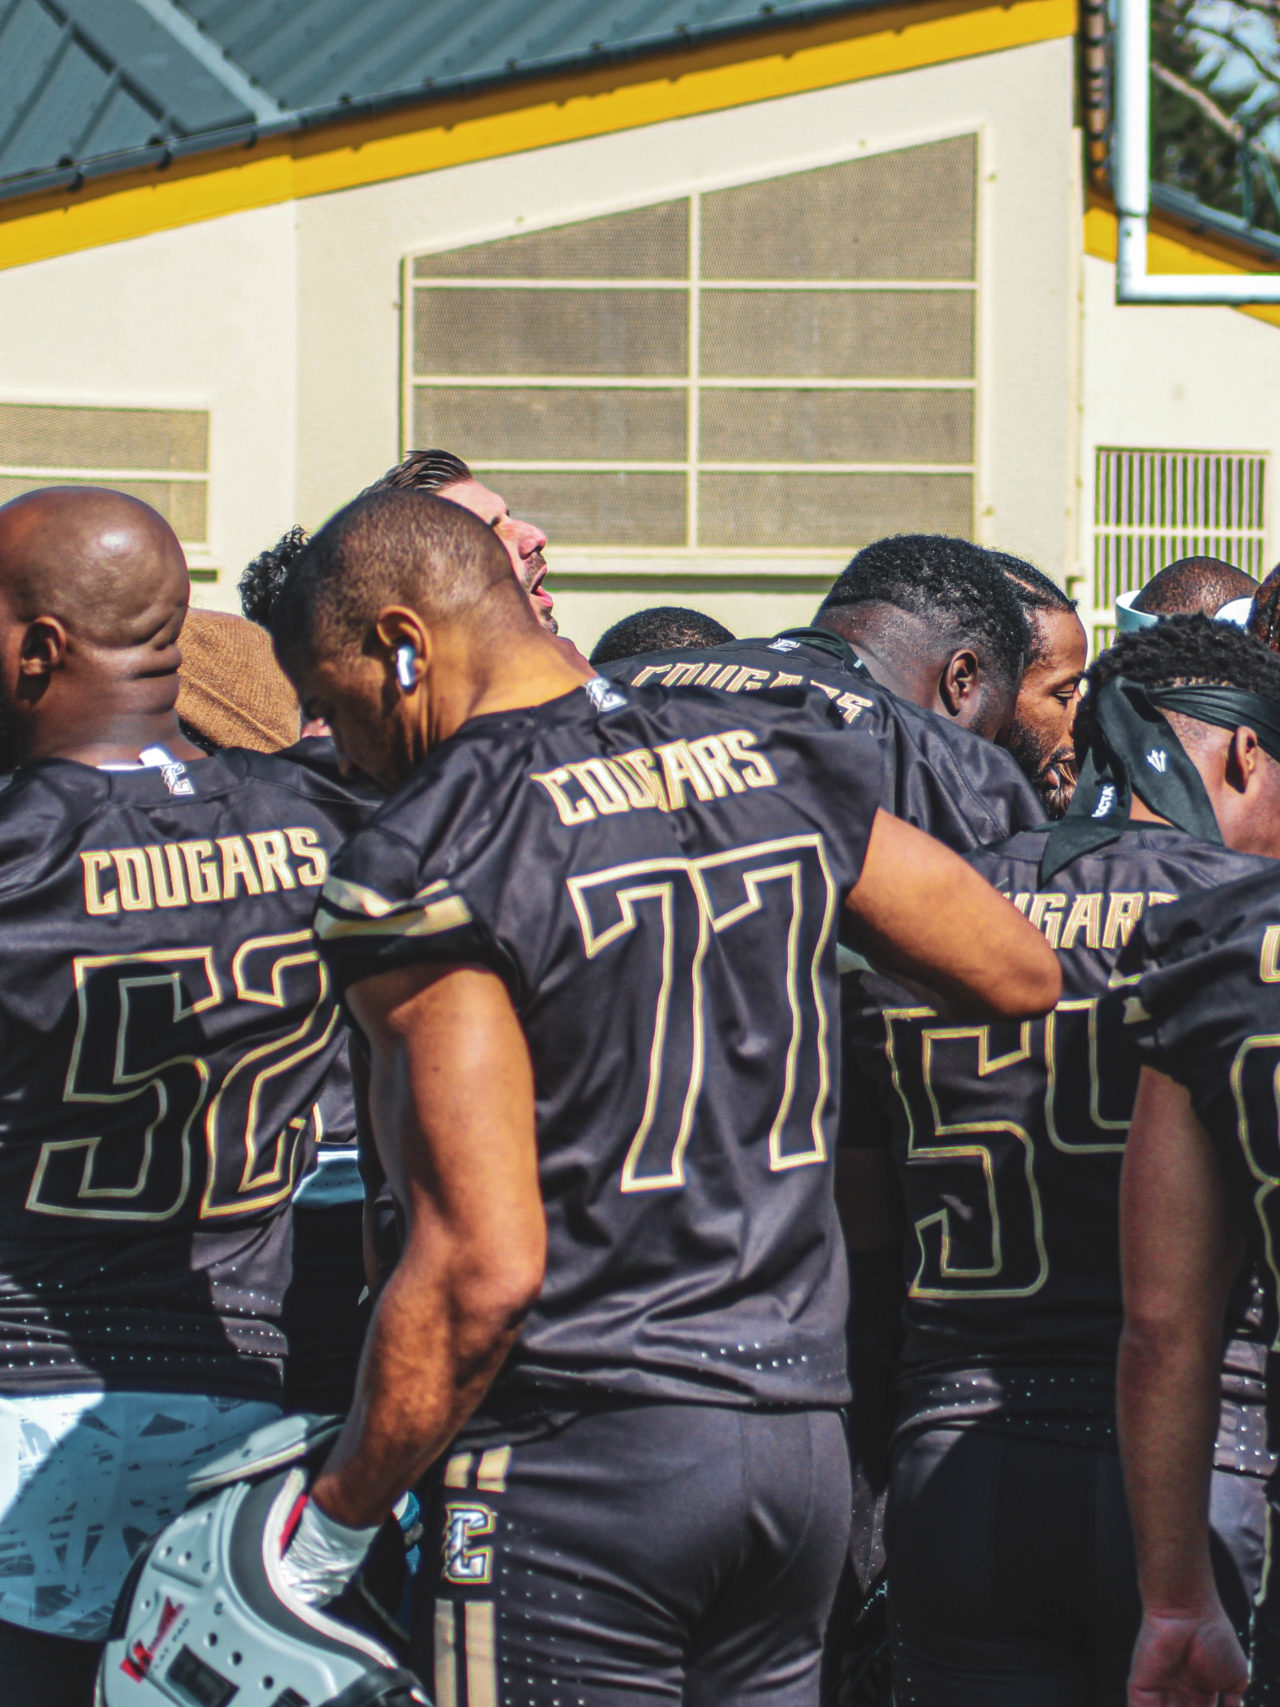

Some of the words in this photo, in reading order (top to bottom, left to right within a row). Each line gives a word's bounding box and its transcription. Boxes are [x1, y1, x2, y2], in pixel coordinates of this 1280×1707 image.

[80, 827, 328, 915] COUGARS
[530, 730, 778, 826] COUGARS
[25, 929, 341, 1222] 52
[567, 834, 836, 1192] 77
